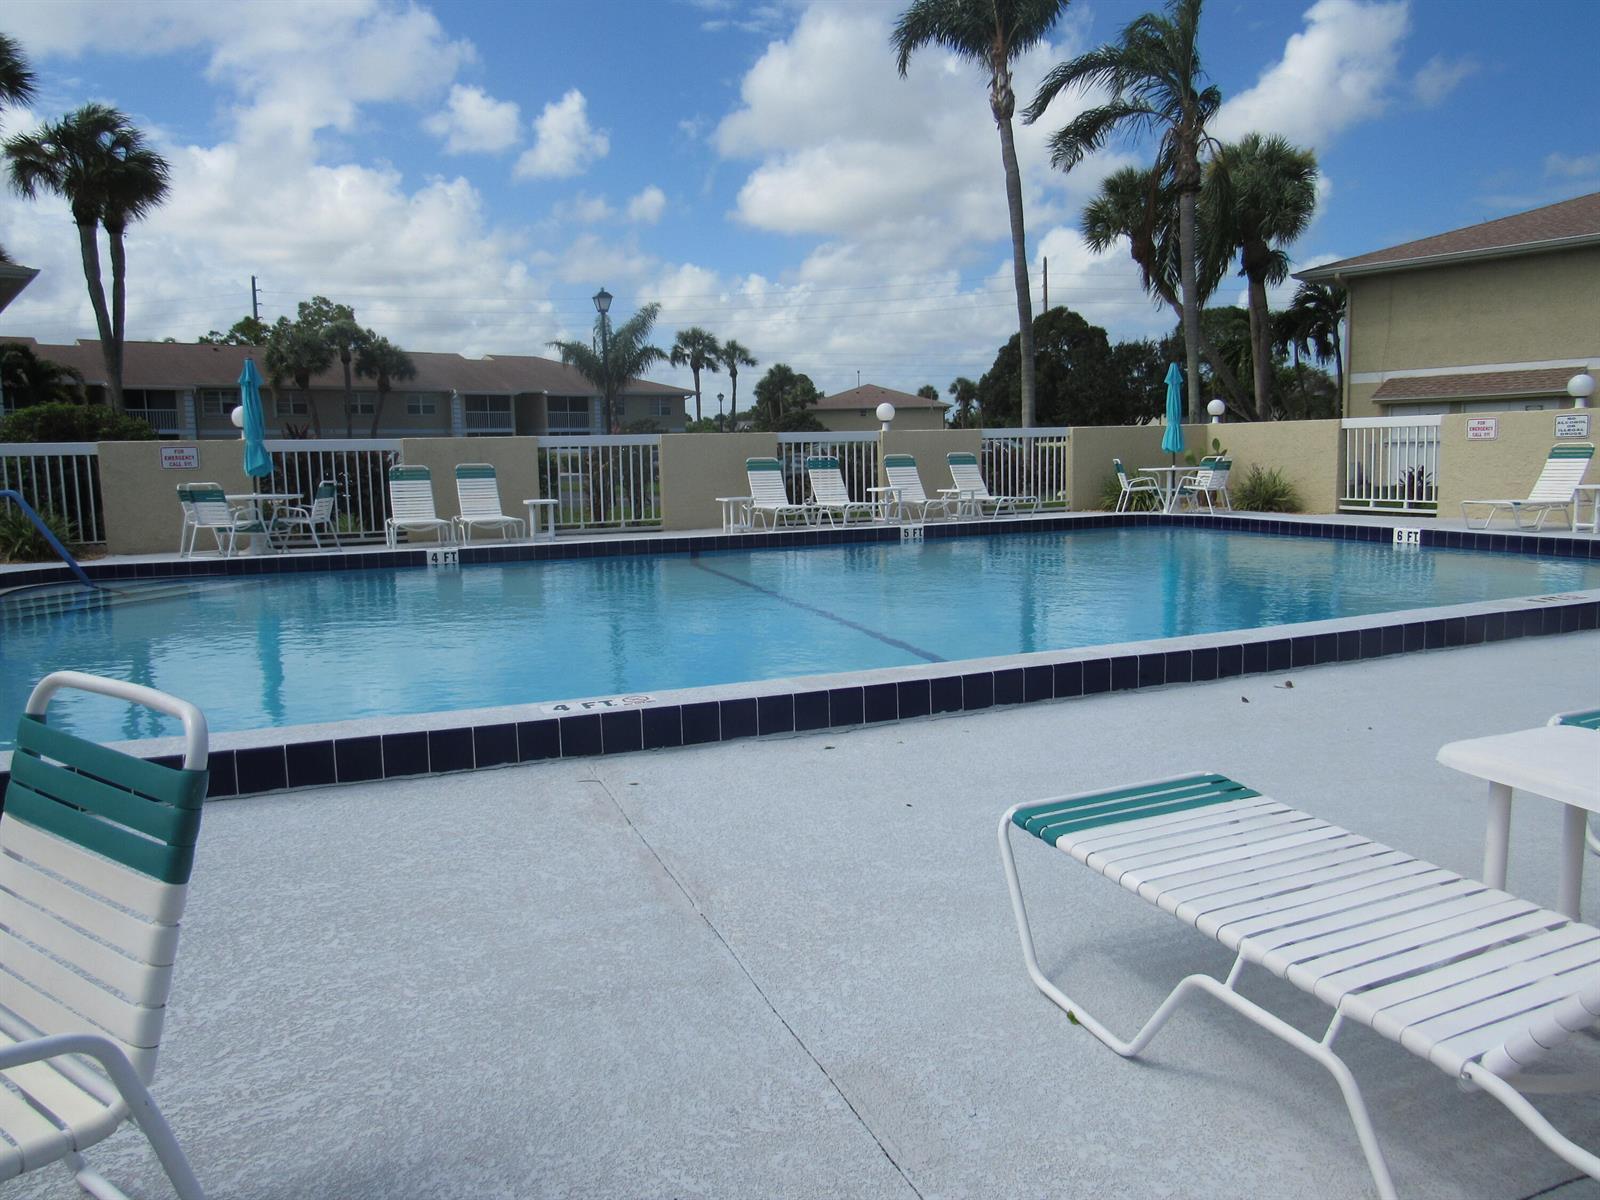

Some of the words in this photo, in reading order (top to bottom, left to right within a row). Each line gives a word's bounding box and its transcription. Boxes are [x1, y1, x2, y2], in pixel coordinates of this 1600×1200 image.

[904, 528, 909, 537] 5
[1397, 530, 1403, 541] 6
[431, 552, 438, 563] 4
[553, 704, 570, 712] 4
